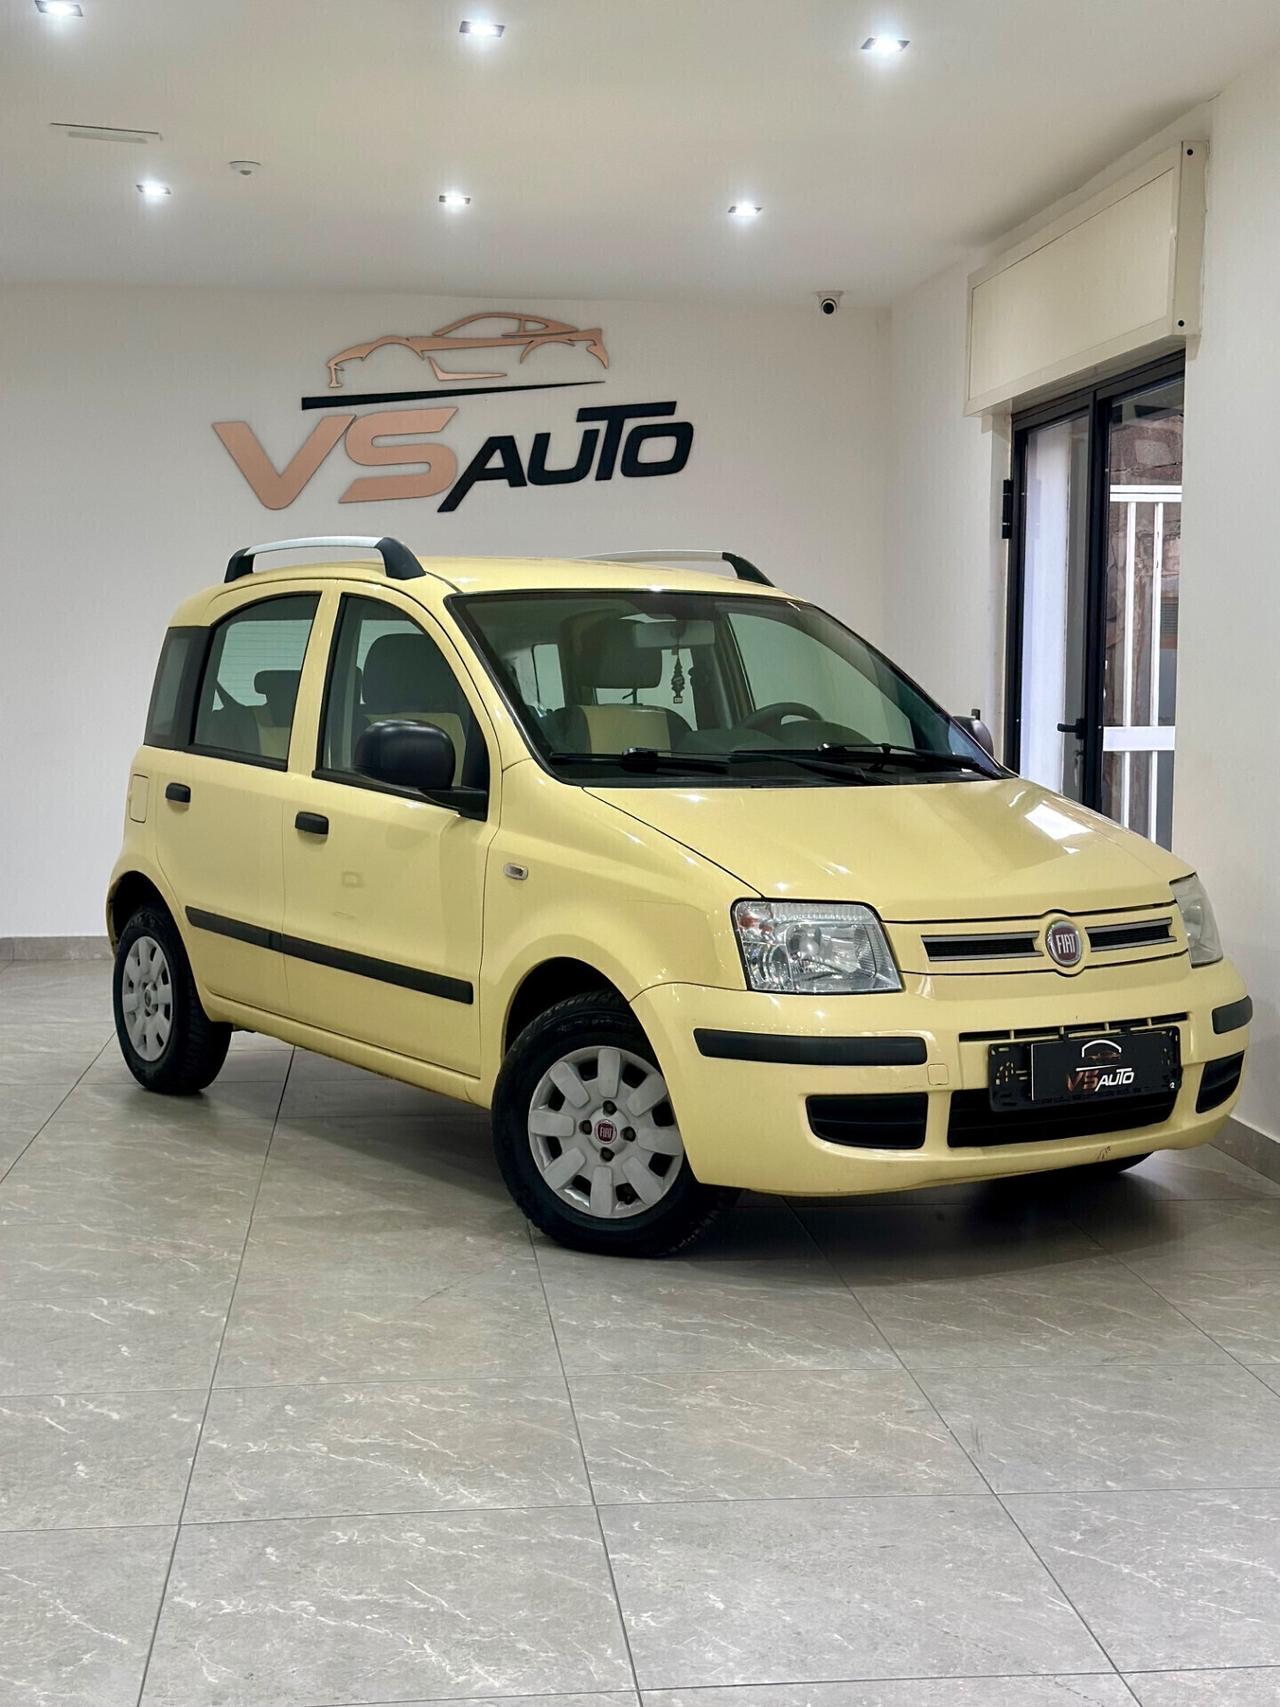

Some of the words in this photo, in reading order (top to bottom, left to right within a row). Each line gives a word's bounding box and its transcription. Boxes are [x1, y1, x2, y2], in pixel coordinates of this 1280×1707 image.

[211, 406, 459, 511] VS
[437, 400, 695, 513] AUTO
[1055, 933, 1076, 954] FIAT
[1066, 1069, 1100, 1092] VS
[1095, 1067, 1135, 1092] AUTO
